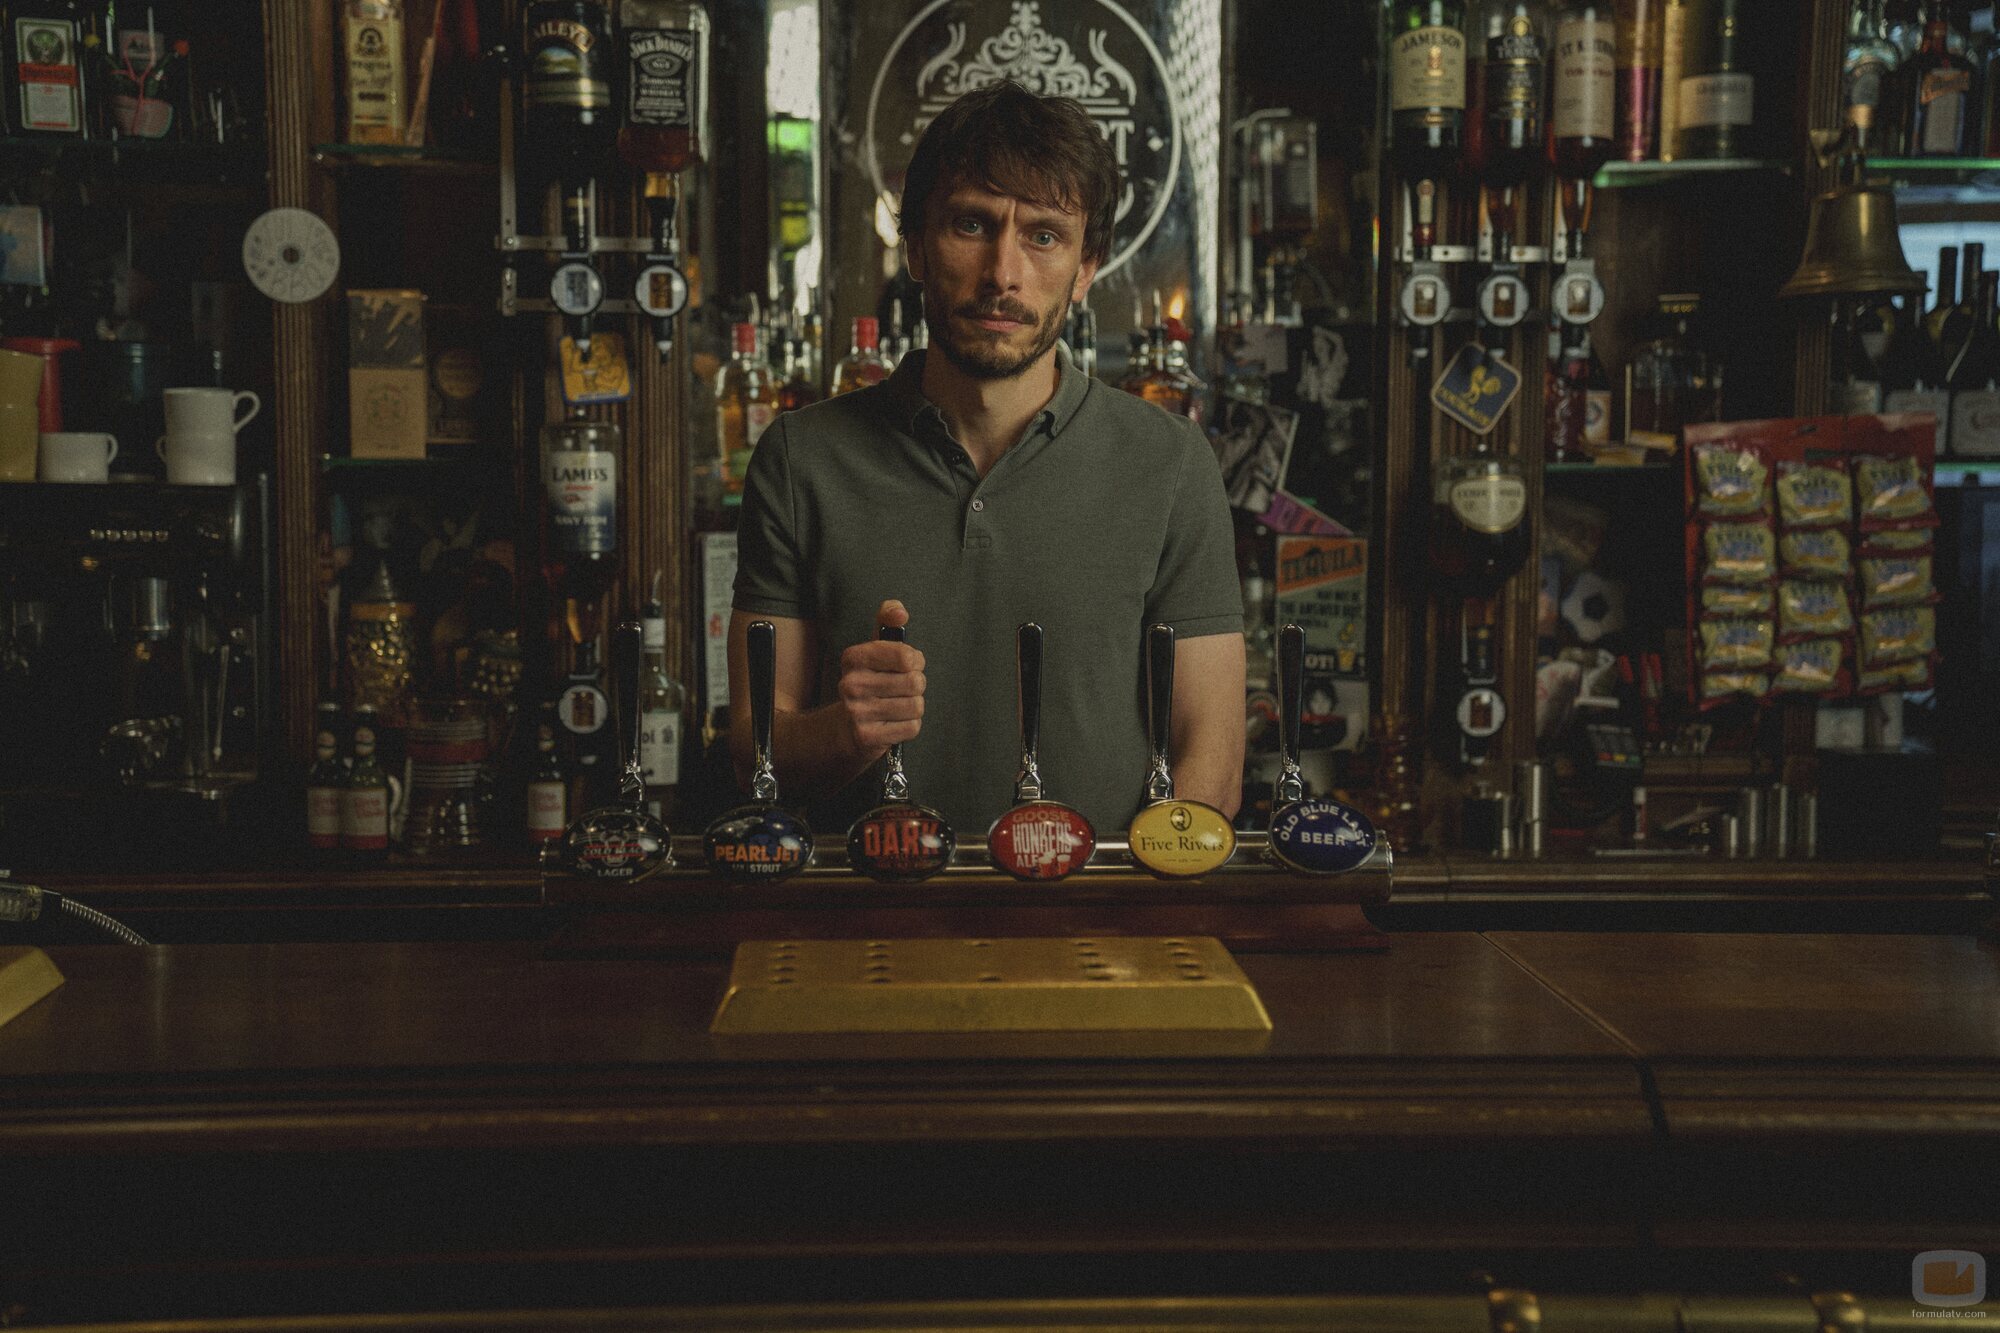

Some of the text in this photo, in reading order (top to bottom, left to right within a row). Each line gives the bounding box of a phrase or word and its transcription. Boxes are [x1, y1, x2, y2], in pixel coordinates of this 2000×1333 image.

[1402, 33, 1461, 54] JAMESON
[1012, 811, 1070, 824] GOOSE
[1280, 814, 1299, 842] OLD
[1299, 804, 1340, 818] BLUE
[864, 820, 940, 858] DARK
[1012, 822, 1073, 855] HONKERS
[1141, 836, 1173, 851] Five
[1300, 831, 1346, 847] BEER
[714, 843, 800, 863] PEARL JET
[597, 868, 634, 878] LAGER
[749, 863, 782, 874] STOUT
